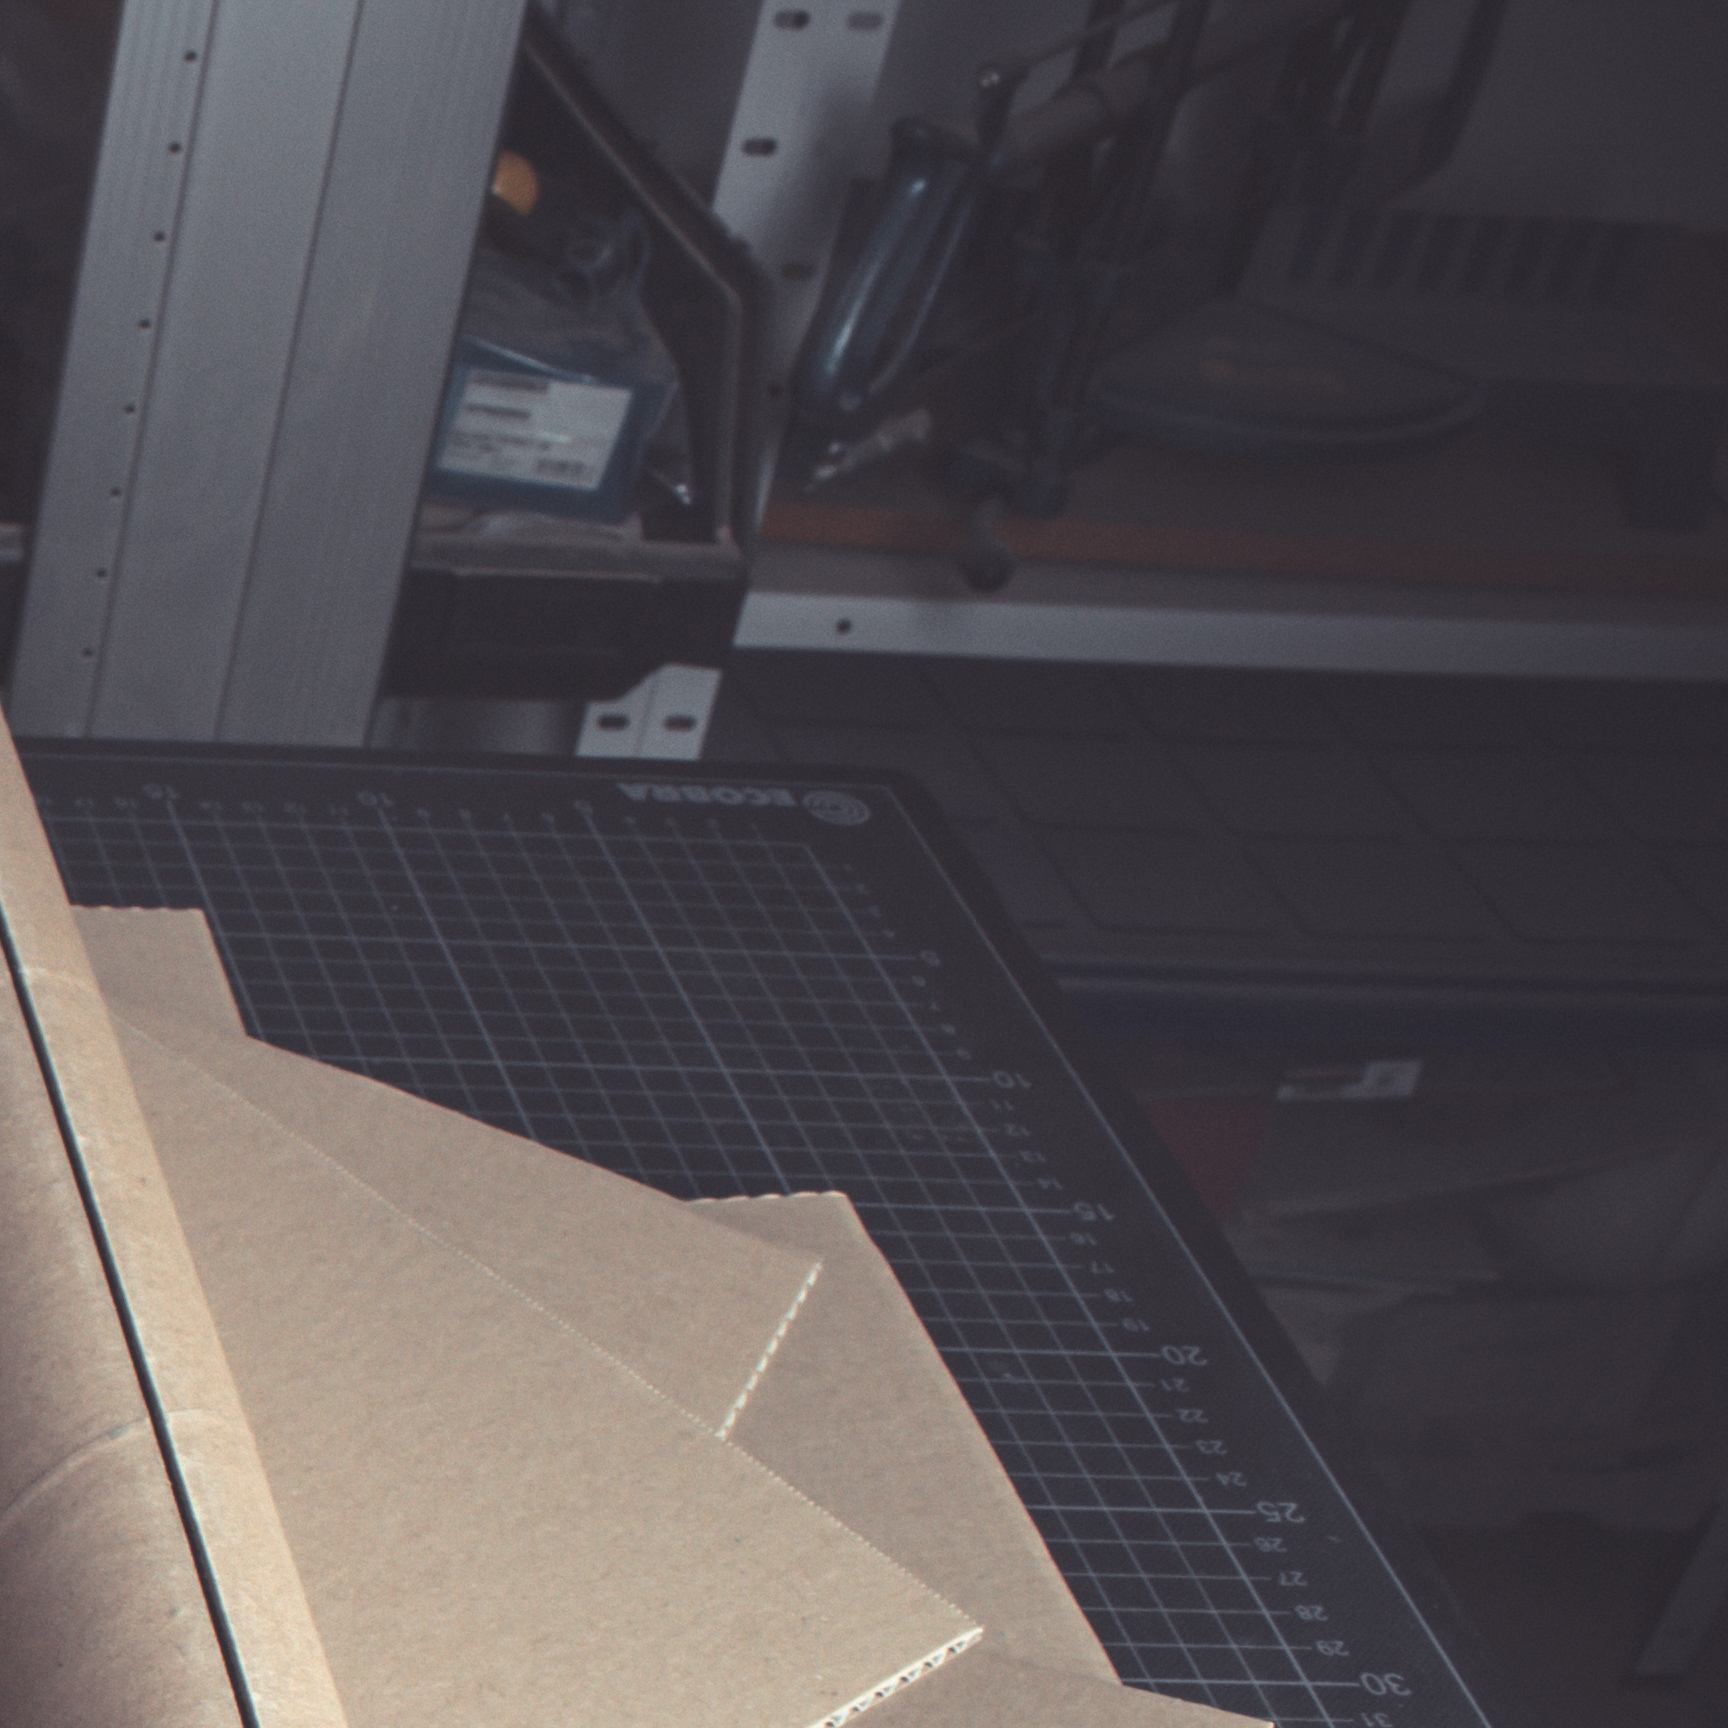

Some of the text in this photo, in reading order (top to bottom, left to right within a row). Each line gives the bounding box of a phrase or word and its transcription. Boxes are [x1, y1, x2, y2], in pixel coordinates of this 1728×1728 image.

[615, 782, 797, 808] ECOBRA
[992, 1070, 1032, 1089] 10
[1091, 1260, 1115, 1274] 17
[1161, 1345, 1208, 1367] 20
[1160, 1378, 1189, 1392] 21
[1175, 1408, 1209, 1424] 22
[1195, 1440, 1227, 1455] 23
[1215, 1471, 1248, 1486] 24
[1256, 1501, 1305, 1524] 25
[1279, 1570, 1308, 1587] 27
[1295, 1604, 1328, 1621] 28
[1315, 1640, 1349, 1656] 29
[1360, 1672, 1412, 1696] 30
[1361, 1712, 1393, 1728] 31
